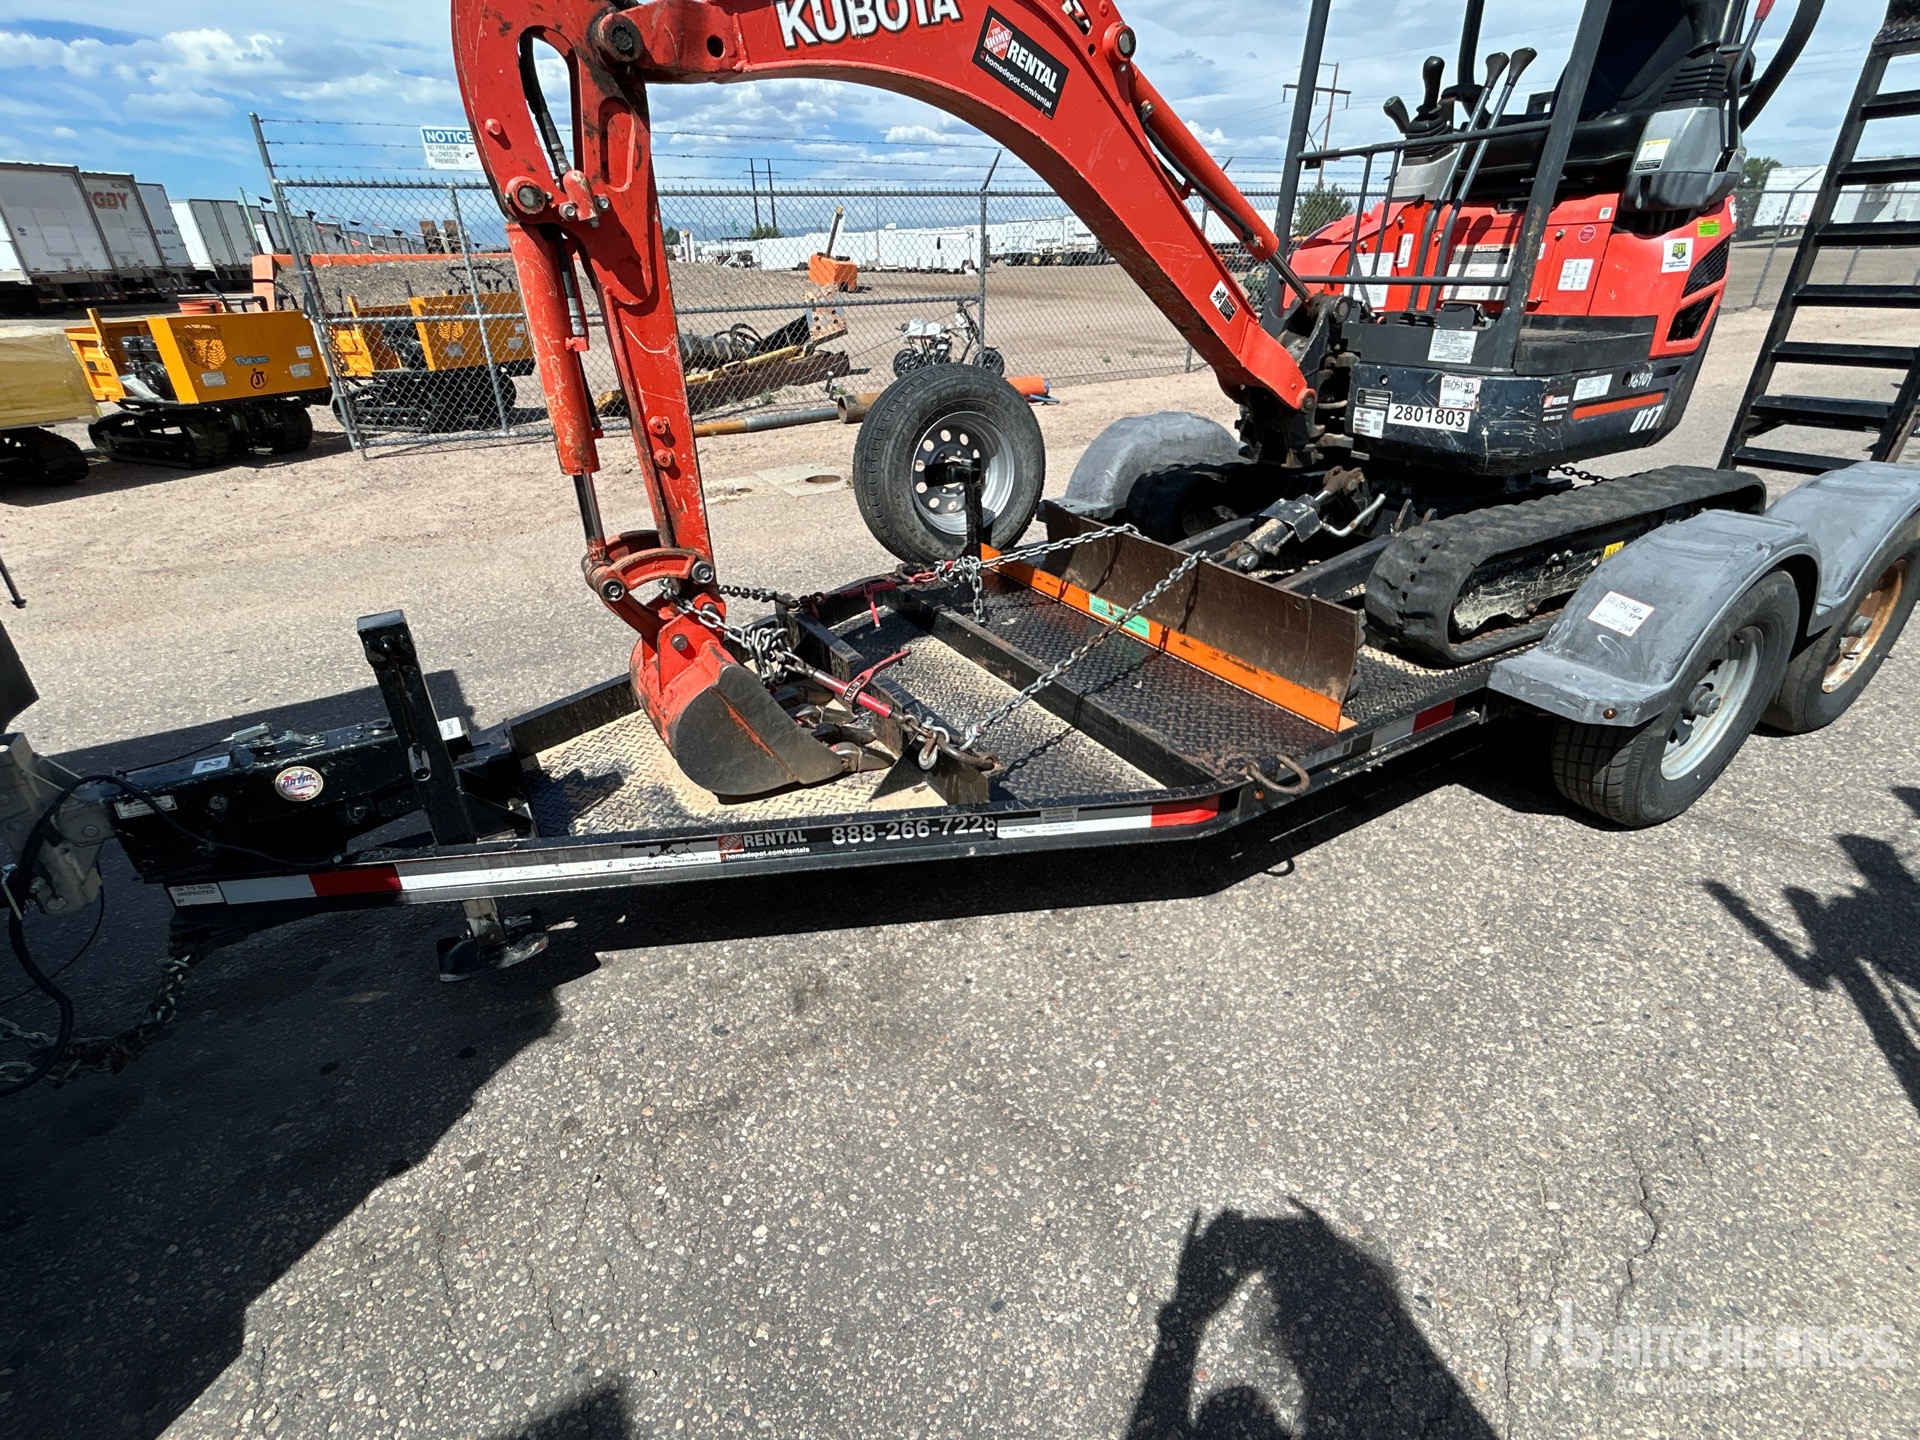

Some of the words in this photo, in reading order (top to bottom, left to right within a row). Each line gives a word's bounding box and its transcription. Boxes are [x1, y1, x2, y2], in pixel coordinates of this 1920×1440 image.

[775, 0, 962, 48] KUBOTA
[990, 26, 1001, 35] THE
[984, 32, 1010, 47] HOME
[992, 42, 1008, 53] DEPOT
[1006, 39, 1058, 94] RENTAL
[984, 53, 1053, 110] homedepot.com/rental
[425, 131, 475, 143] NOTICE
[1393, 405, 1466, 428] 2801803
[1628, 404, 1665, 433] U17
[742, 830, 808, 848] RENTAL
[831, 815, 996, 845] 888-266-7228
[724, 845, 811, 861] homedepot.com/rentals
